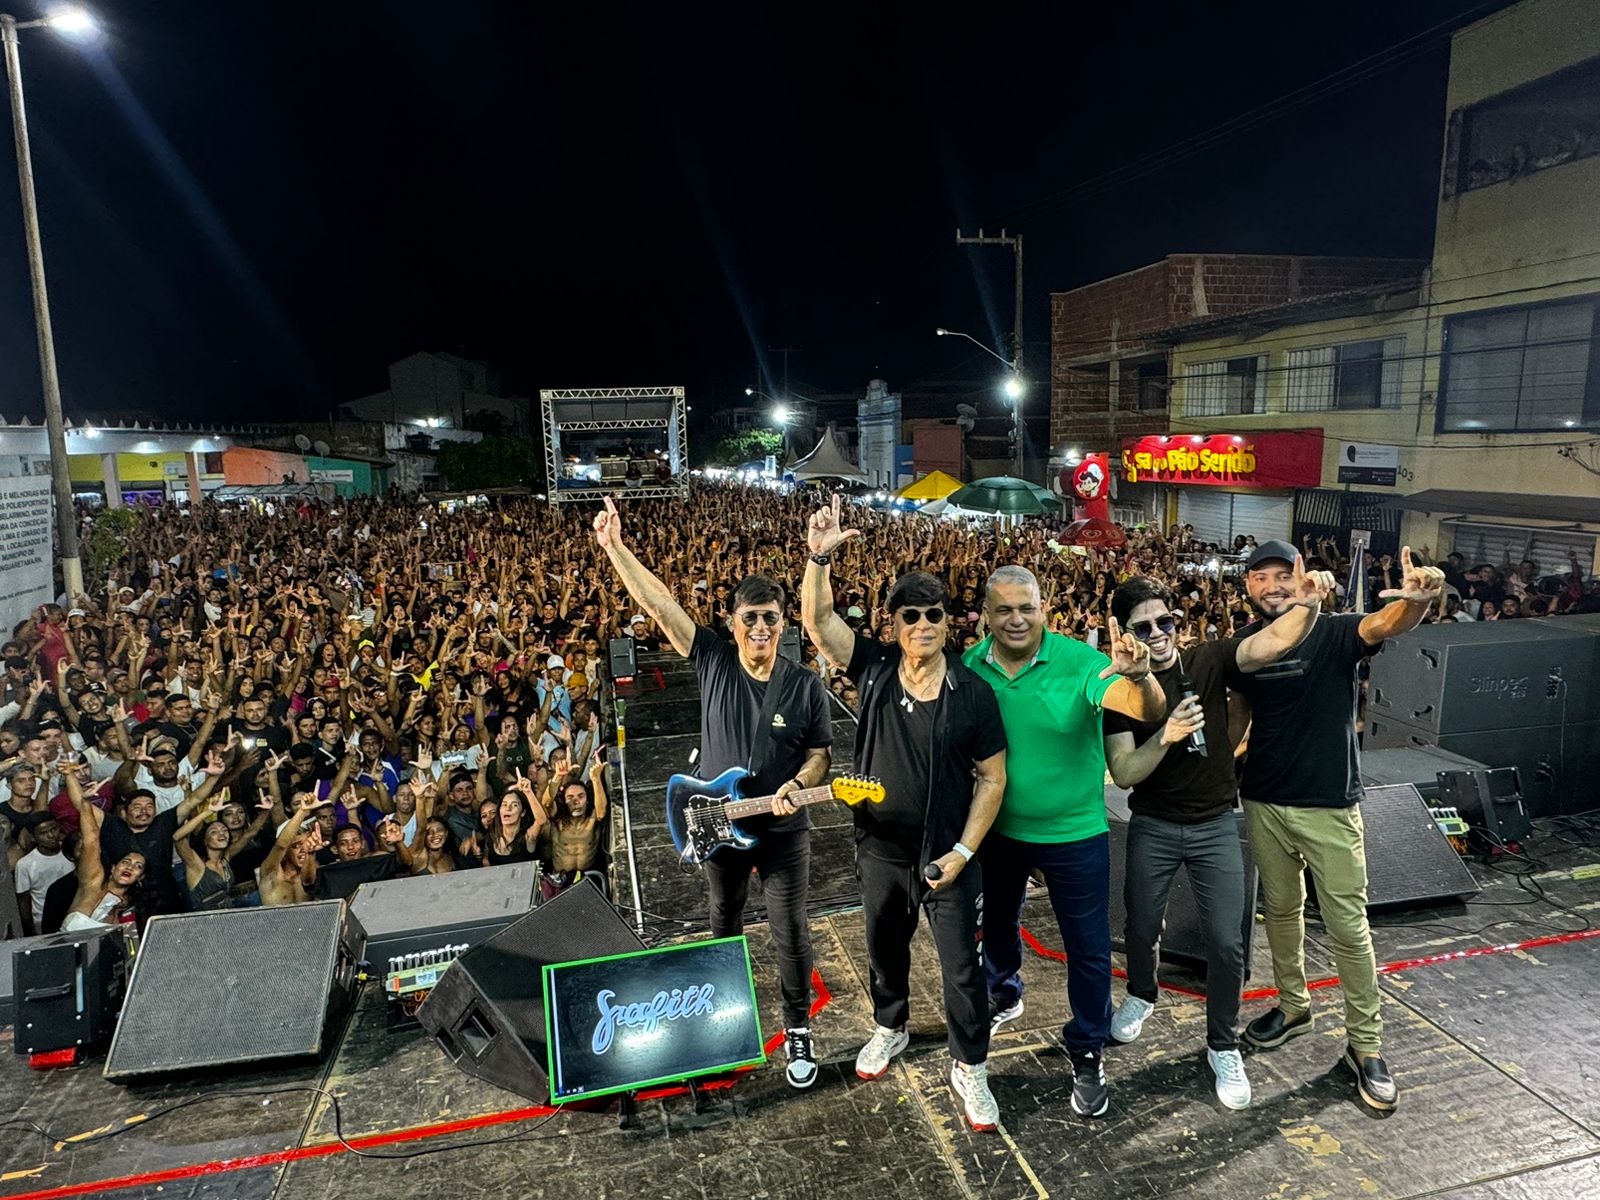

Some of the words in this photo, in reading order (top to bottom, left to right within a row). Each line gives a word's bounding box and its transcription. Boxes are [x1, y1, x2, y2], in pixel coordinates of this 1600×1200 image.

[1167, 446, 1199, 471] Pão
[1200, 444, 1256, 474] Seridó
[1398, 465, 1414, 481] 103
